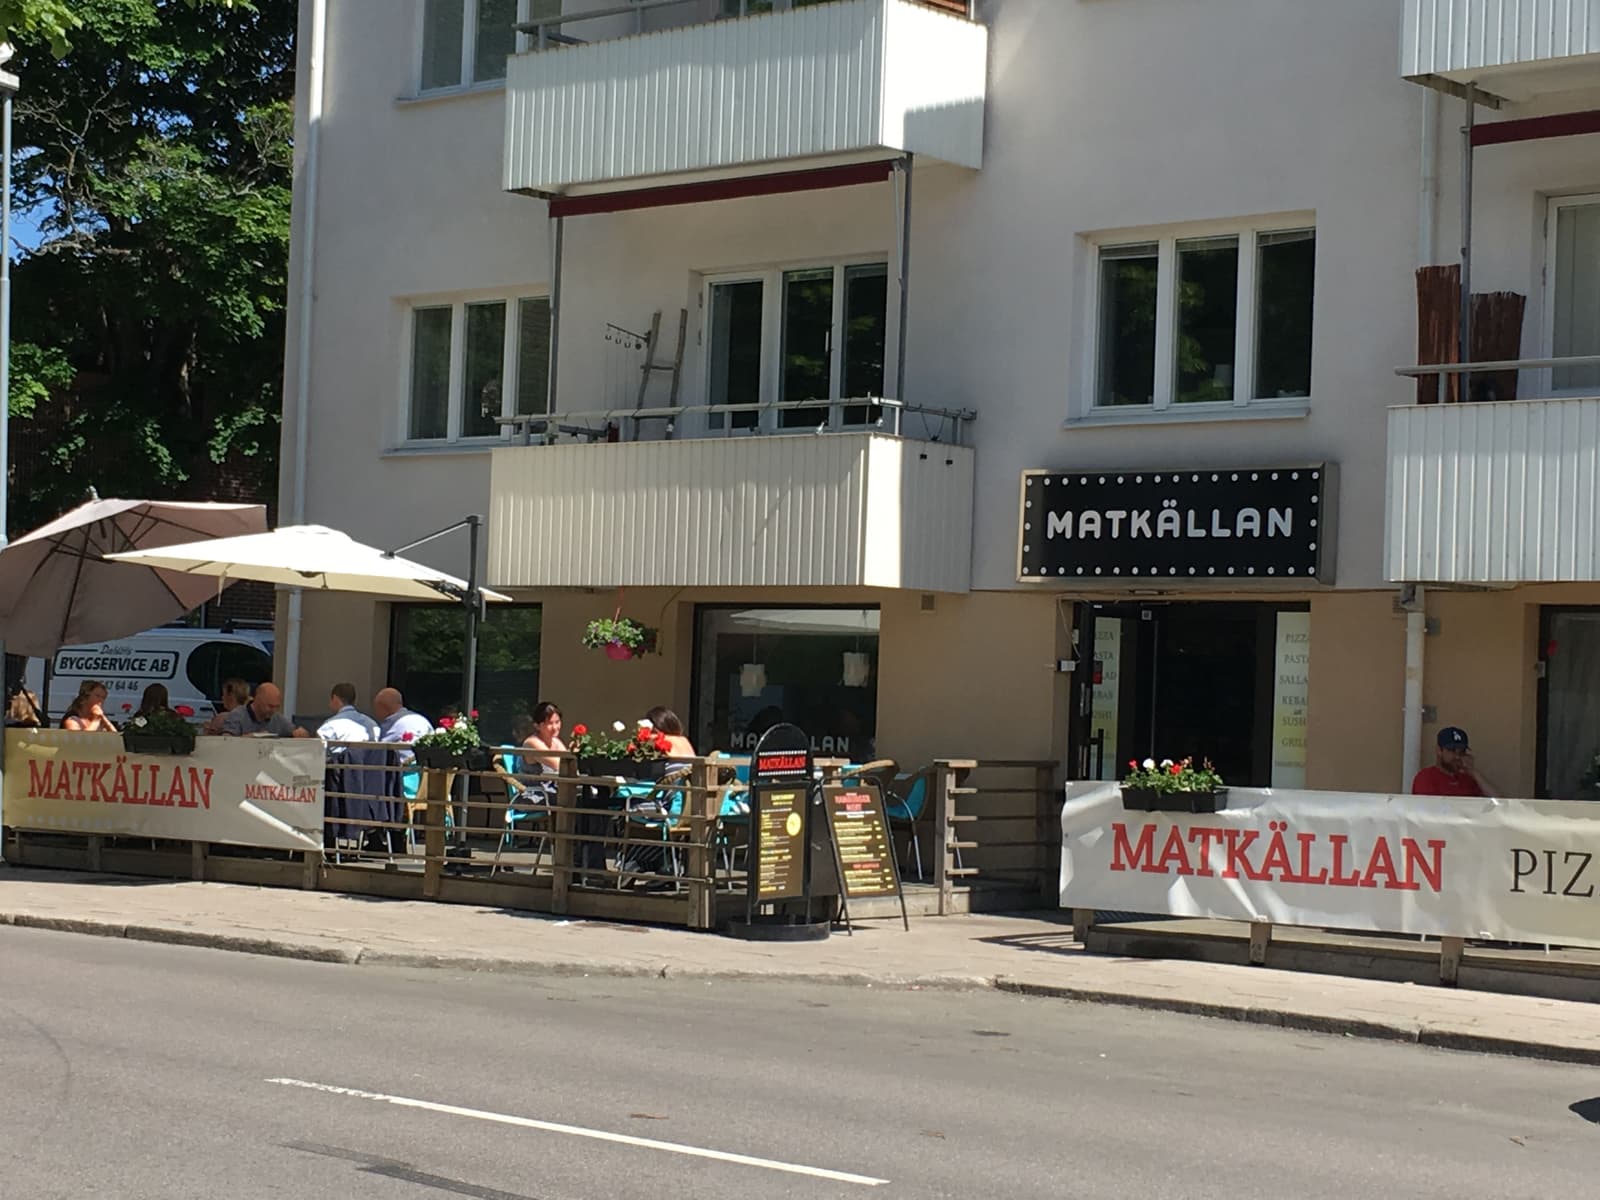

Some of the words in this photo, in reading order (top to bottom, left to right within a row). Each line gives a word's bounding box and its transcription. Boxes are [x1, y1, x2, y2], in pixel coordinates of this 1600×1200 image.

[1047, 499, 1293, 539] MATKÄLLAN
[1286, 633, 1309, 643] PIZZ
[59, 656, 148, 671] BYGGSERVICE
[149, 658, 170, 672] AB
[1284, 654, 1308, 664] PAST
[730, 733, 849, 752] MALAN
[28, 756, 214, 809] MATKÄLLAN
[1110, 821, 1446, 892] MATKÄLLAN
[1510, 848, 1600, 898] PIZ
